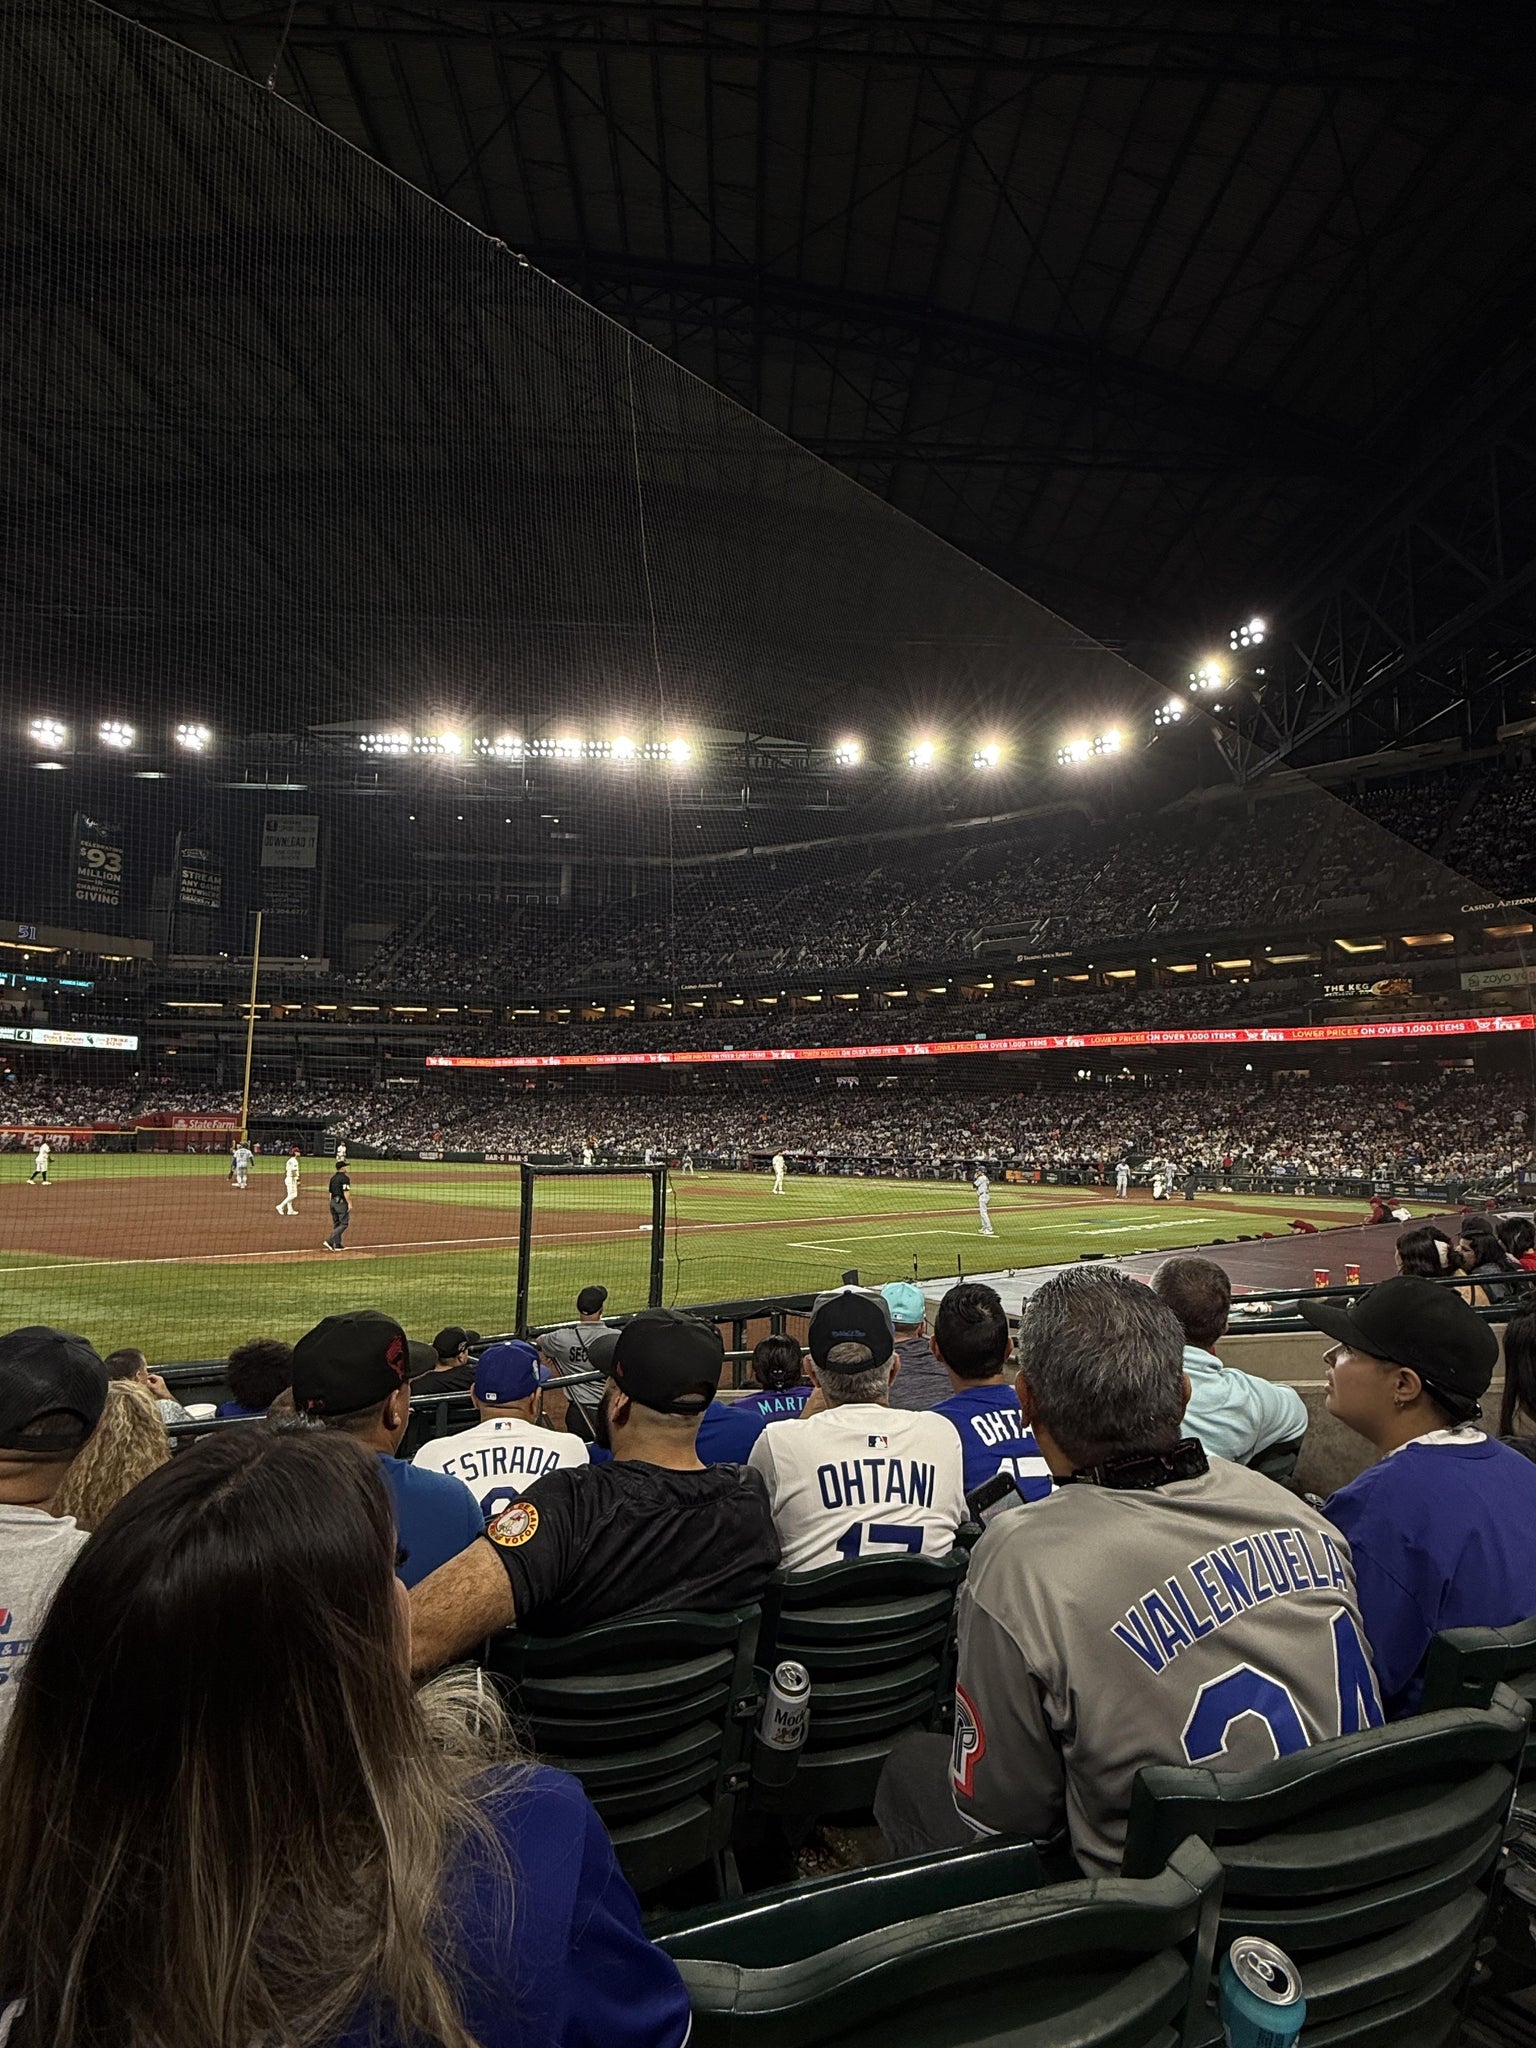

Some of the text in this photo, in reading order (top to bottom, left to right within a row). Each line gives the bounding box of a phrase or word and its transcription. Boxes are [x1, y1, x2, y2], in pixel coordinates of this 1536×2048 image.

[77, 866, 121, 881] MILLION
[182, 870, 222, 885] STREAM
[75, 890, 119, 905] GIVING
[18, 925, 36, 940] 51
[1324, 983, 1369, 993] THE KEG
[1292, 1030, 1325, 1038] LOWER
[1326, 1028, 1359, 1036] PRICES
[1378, 1026, 1404, 1034] OVER
[1406, 1025, 1433, 1034] 1,000
[1435, 1023, 1465, 1031] ITEMS
[757, 1396, 810, 1416] MART
[442, 1446, 560, 1482] ESTRADA
[816, 1458, 935, 1510] OHTANI
[1110, 1528, 1351, 1676] VALENZUELA
